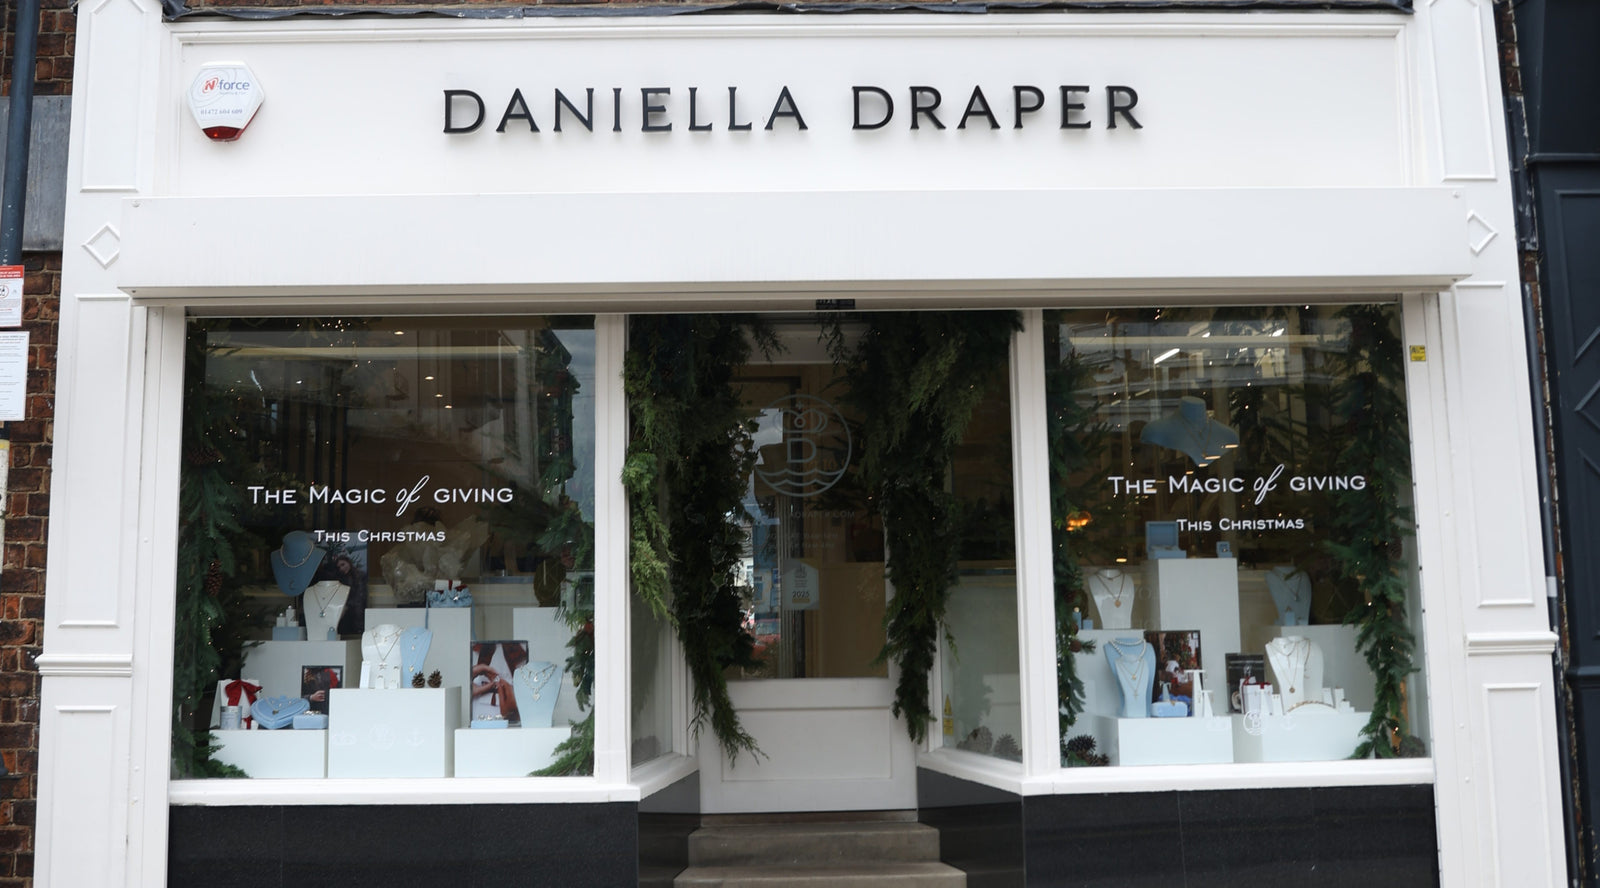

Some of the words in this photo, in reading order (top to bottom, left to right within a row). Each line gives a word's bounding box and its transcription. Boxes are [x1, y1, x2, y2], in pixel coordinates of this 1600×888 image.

[443, 85, 808, 133] DANIELLA
[851, 85, 1143, 131] DRAPER
[395, 475, 430, 517] of
[434, 487, 514, 503] GIVING
[1253, 464, 1285, 505] of
[1290, 475, 1366, 492] GIVING
